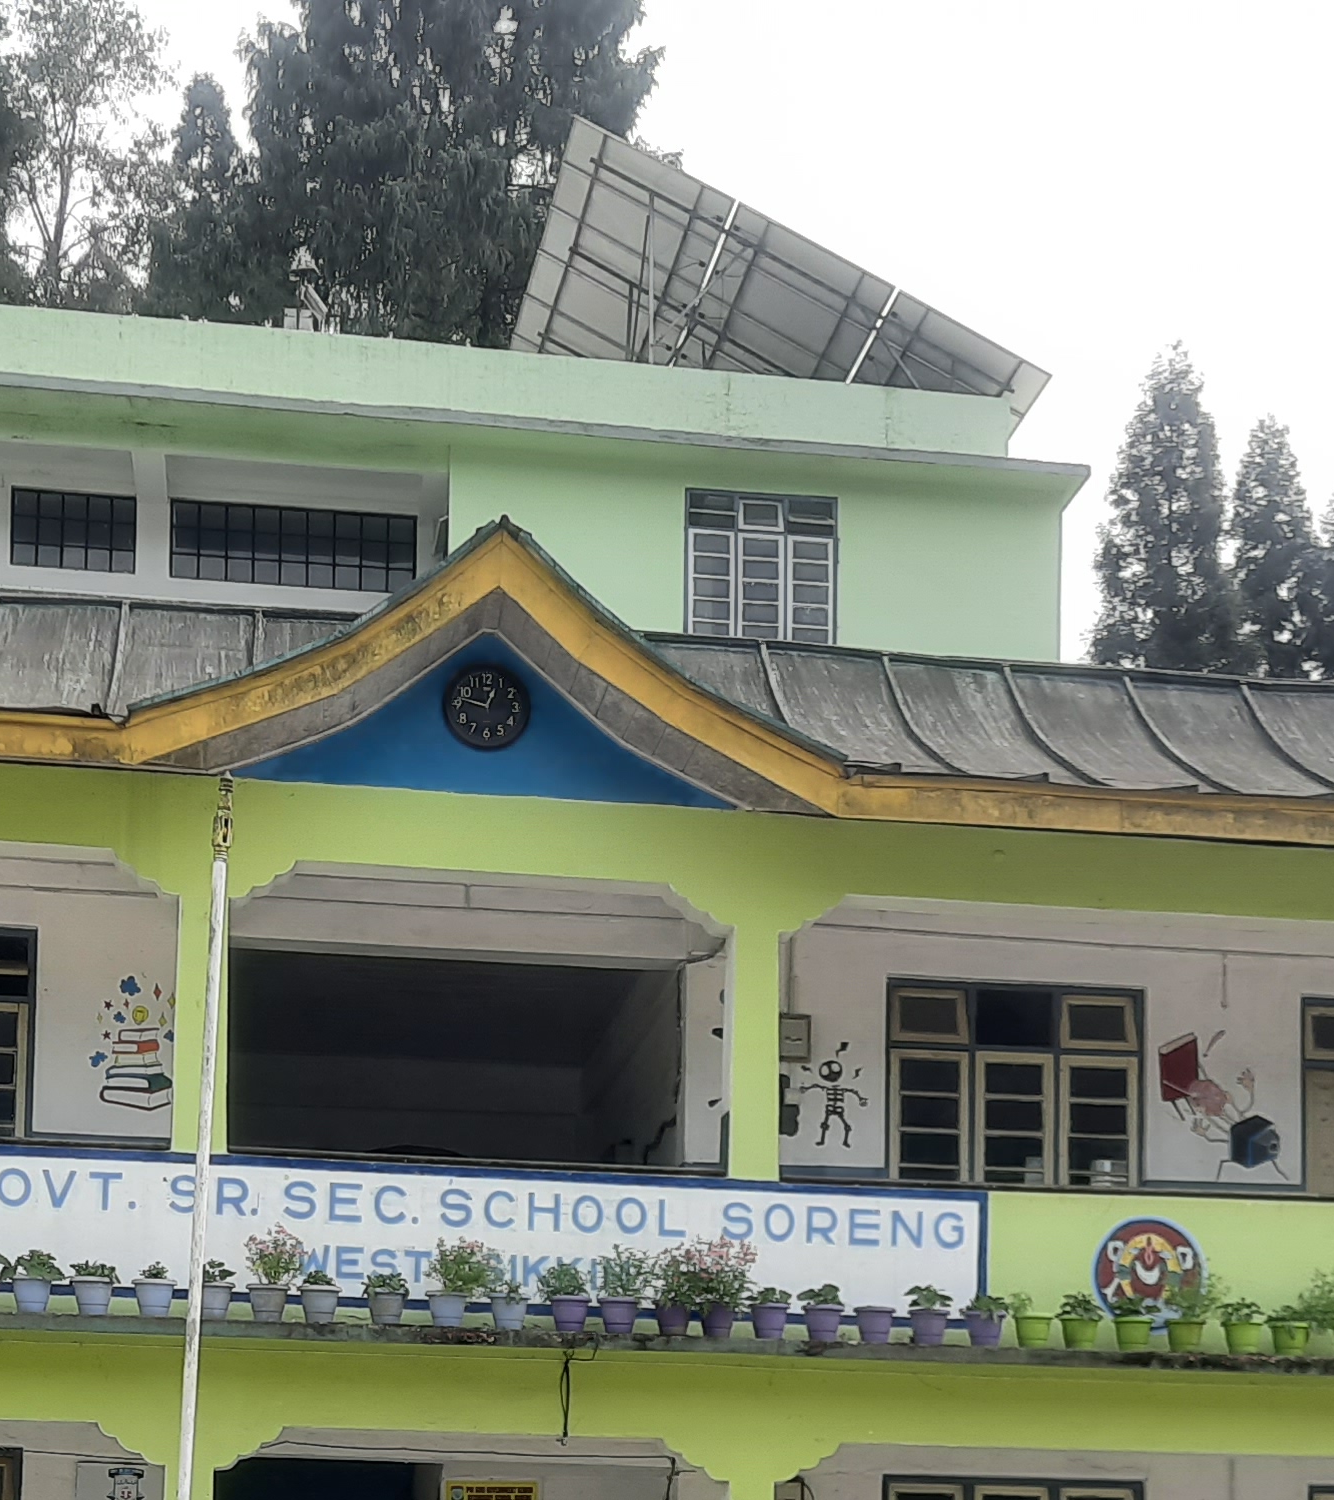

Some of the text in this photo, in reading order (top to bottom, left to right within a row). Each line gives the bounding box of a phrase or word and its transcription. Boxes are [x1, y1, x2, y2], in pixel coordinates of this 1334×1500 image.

[169, 1174, 259, 1217] SR.
[283, 1180, 421, 1226] SEC.
[439, 1188, 688, 1240] SCHOOL
[721, 1201, 967, 1251] SORENG
[301, 1244, 433, 1284] WEST
